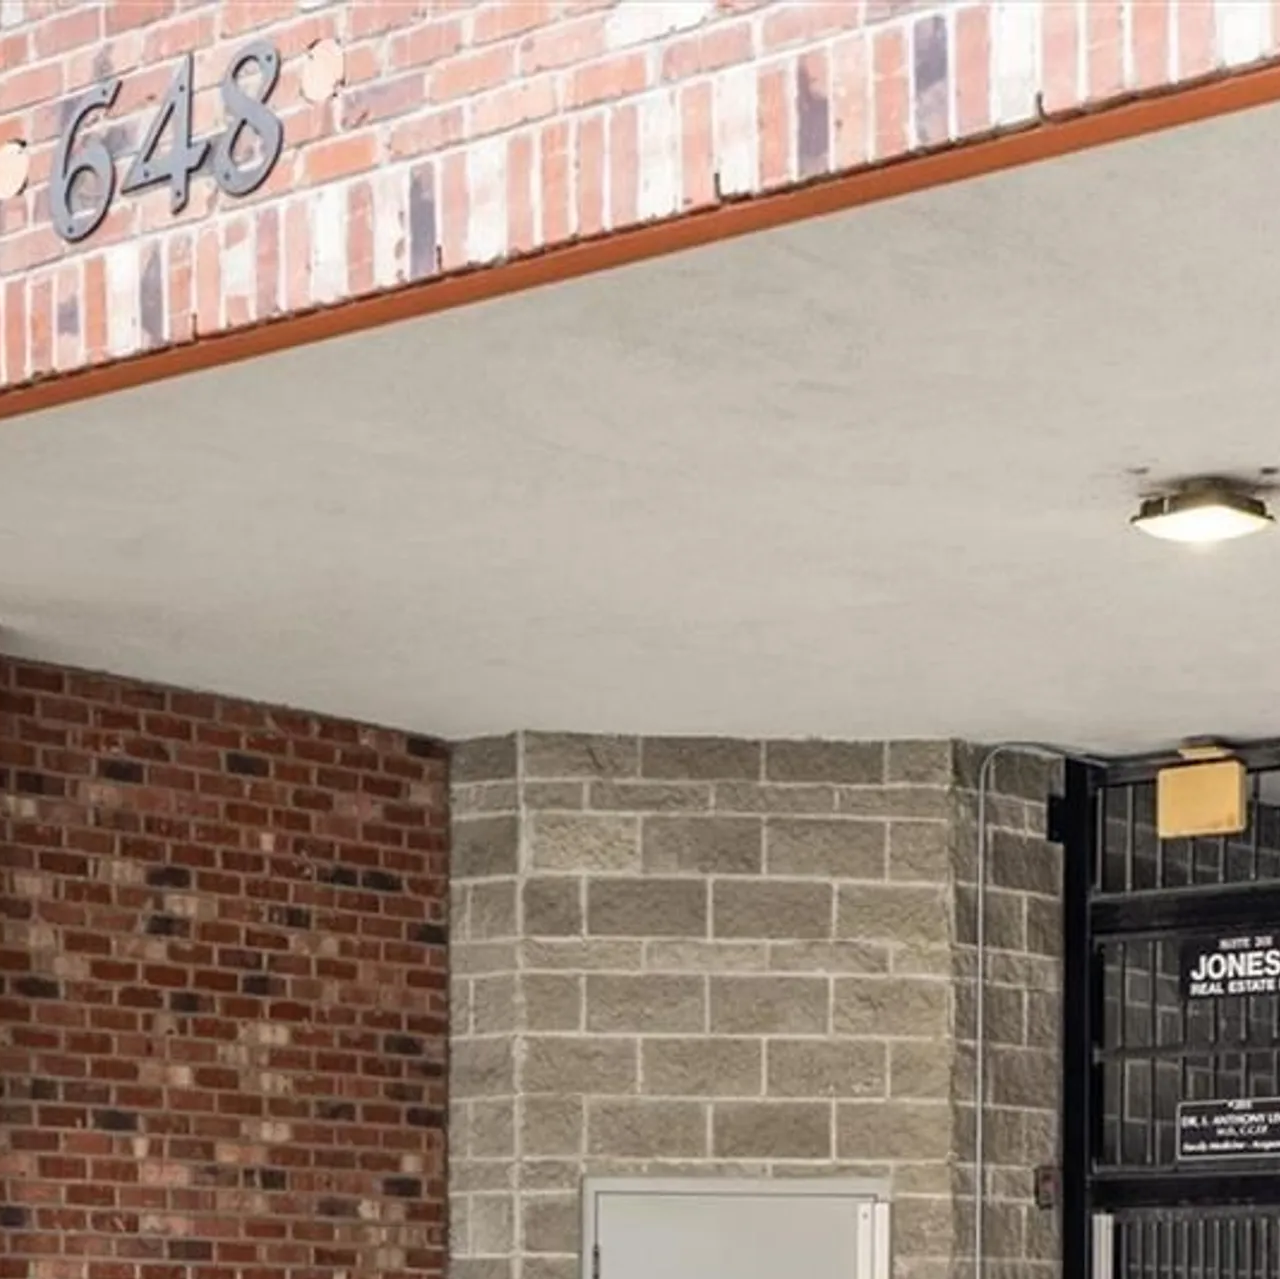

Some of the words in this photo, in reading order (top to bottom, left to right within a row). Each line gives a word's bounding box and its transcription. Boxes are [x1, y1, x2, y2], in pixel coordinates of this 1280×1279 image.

[51, 40, 284, 243] 648
[1190, 983, 1224, 996] REAL
[1228, 979, 1275, 994] ESTATE
